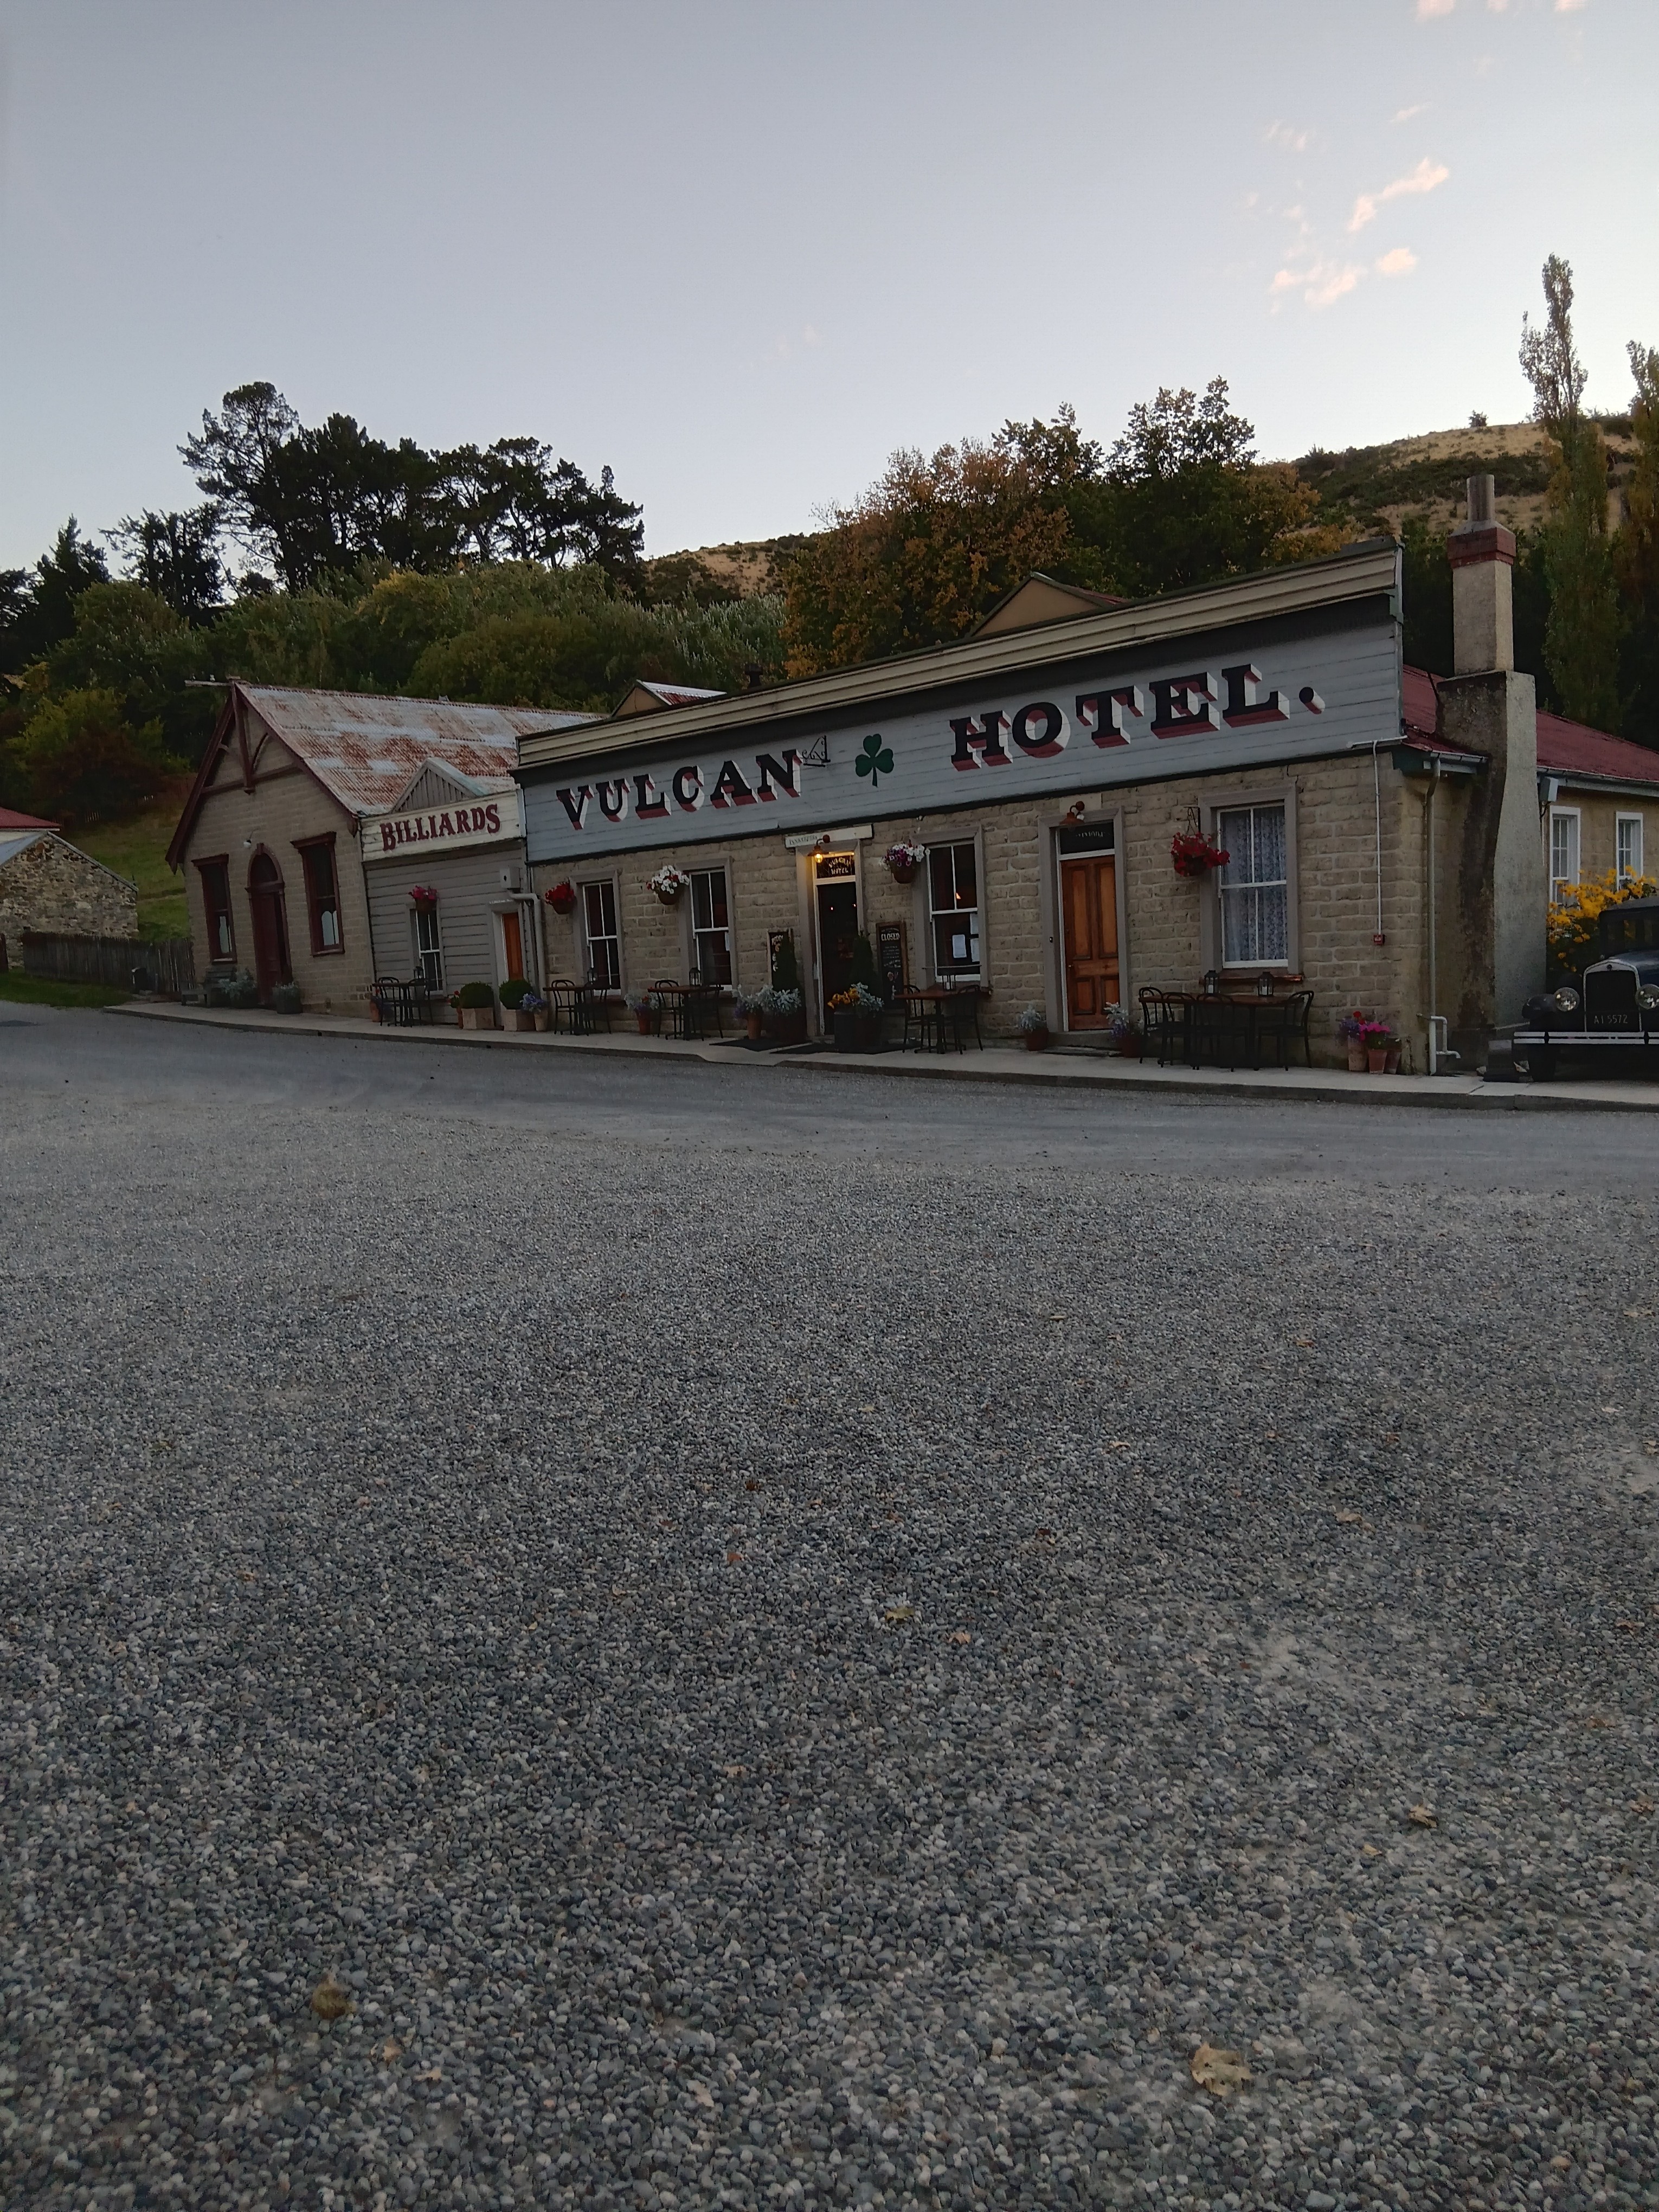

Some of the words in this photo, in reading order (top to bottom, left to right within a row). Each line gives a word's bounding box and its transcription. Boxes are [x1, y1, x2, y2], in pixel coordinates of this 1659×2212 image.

[556, 749, 802, 830] VULCAN
[380, 803, 500, 852] BILLIARDS
[881, 933, 900, 941] CLOSED
